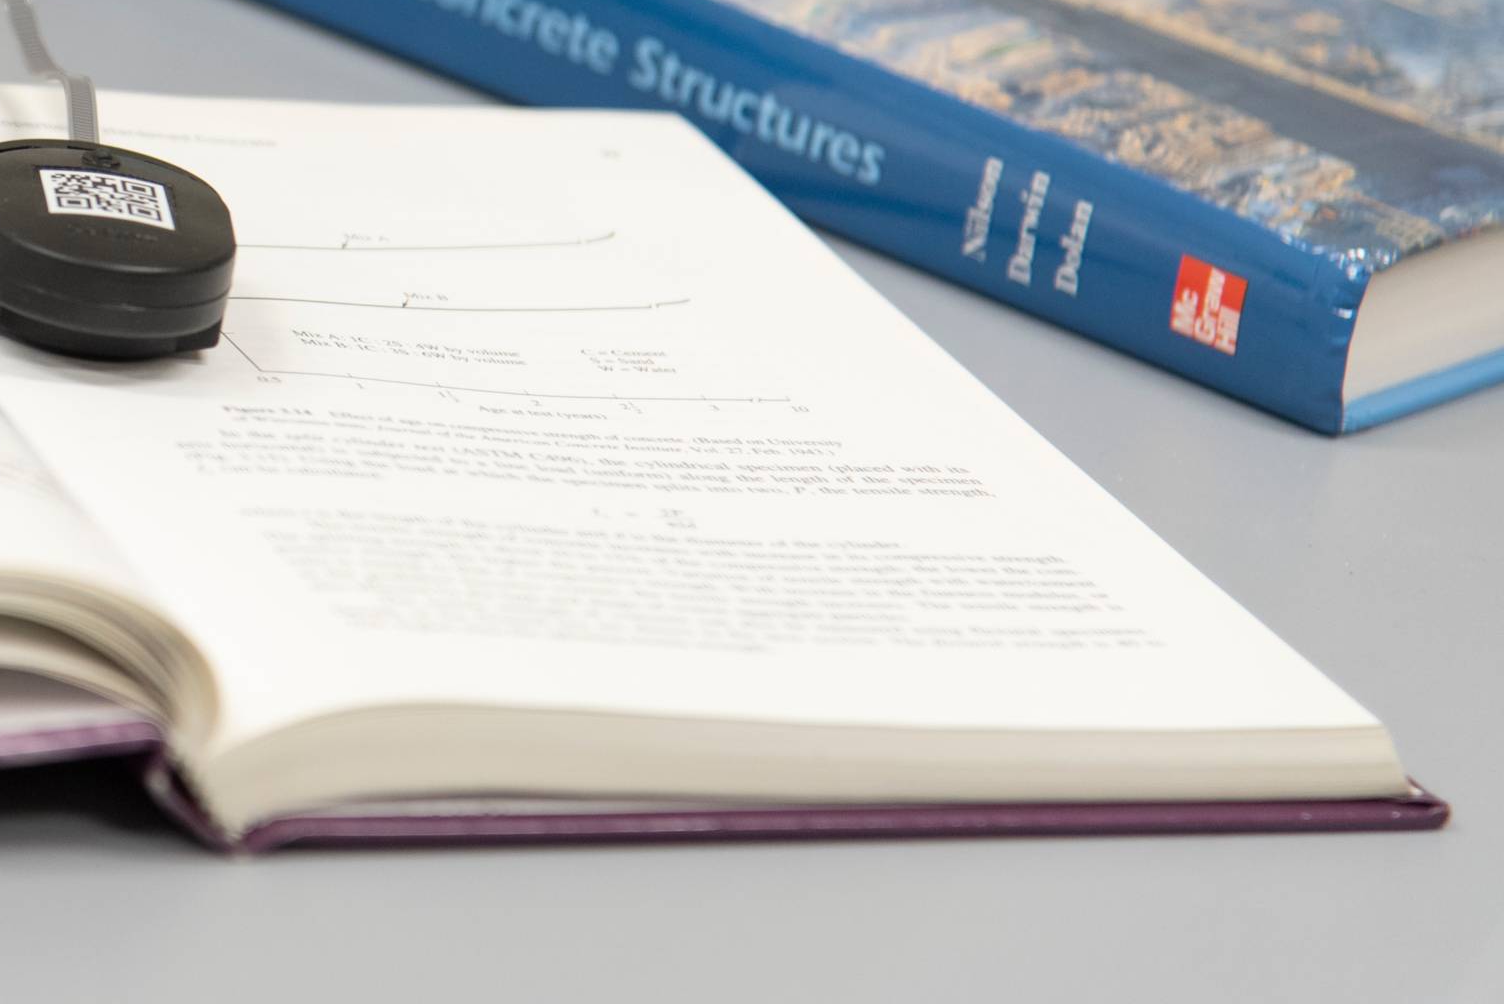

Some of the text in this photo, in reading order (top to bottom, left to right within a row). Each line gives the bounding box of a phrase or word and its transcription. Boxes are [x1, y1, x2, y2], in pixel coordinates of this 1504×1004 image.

[628, 36, 887, 186] Structures
[961, 156, 1004, 262] Nilson
[1007, 170, 1051, 286] Darwin
[1054, 199, 1094, 296] Dolan
[1172, 287, 1199, 336] Mc
[291, 329, 323, 339] Mix
[300, 337, 333, 347] Mix
[1215, 305, 1240, 356] Hill
[478, 404, 508, 416] Age
[526, 408, 553, 417] test
[449, 423, 539, 437] compressive
[542, 431, 601, 443] strength
[692, 435, 743, 446] (Based
[767, 437, 843, 449] University
[481, 434, 552, 446] American
[554, 440, 620, 451] Concrete
[451, 446, 523, 460] (ASTM
[597, 457, 628, 467] the
[633, 459, 731, 472] cylindrical
[736, 462, 823, 474] specimen
[827, 463, 895, 475] (placed
[900, 464, 943, 474] with
[583, 467, 673, 481] (uniform)
[679, 472, 731, 484] along
[736, 473, 766, 483] the
[769, 474, 829, 486] length
[861, 475, 892, 485] the
[898, 476, 984, 488] specimen
[818, 485, 848, 496] the
[851, 486, 913, 497] tensile
